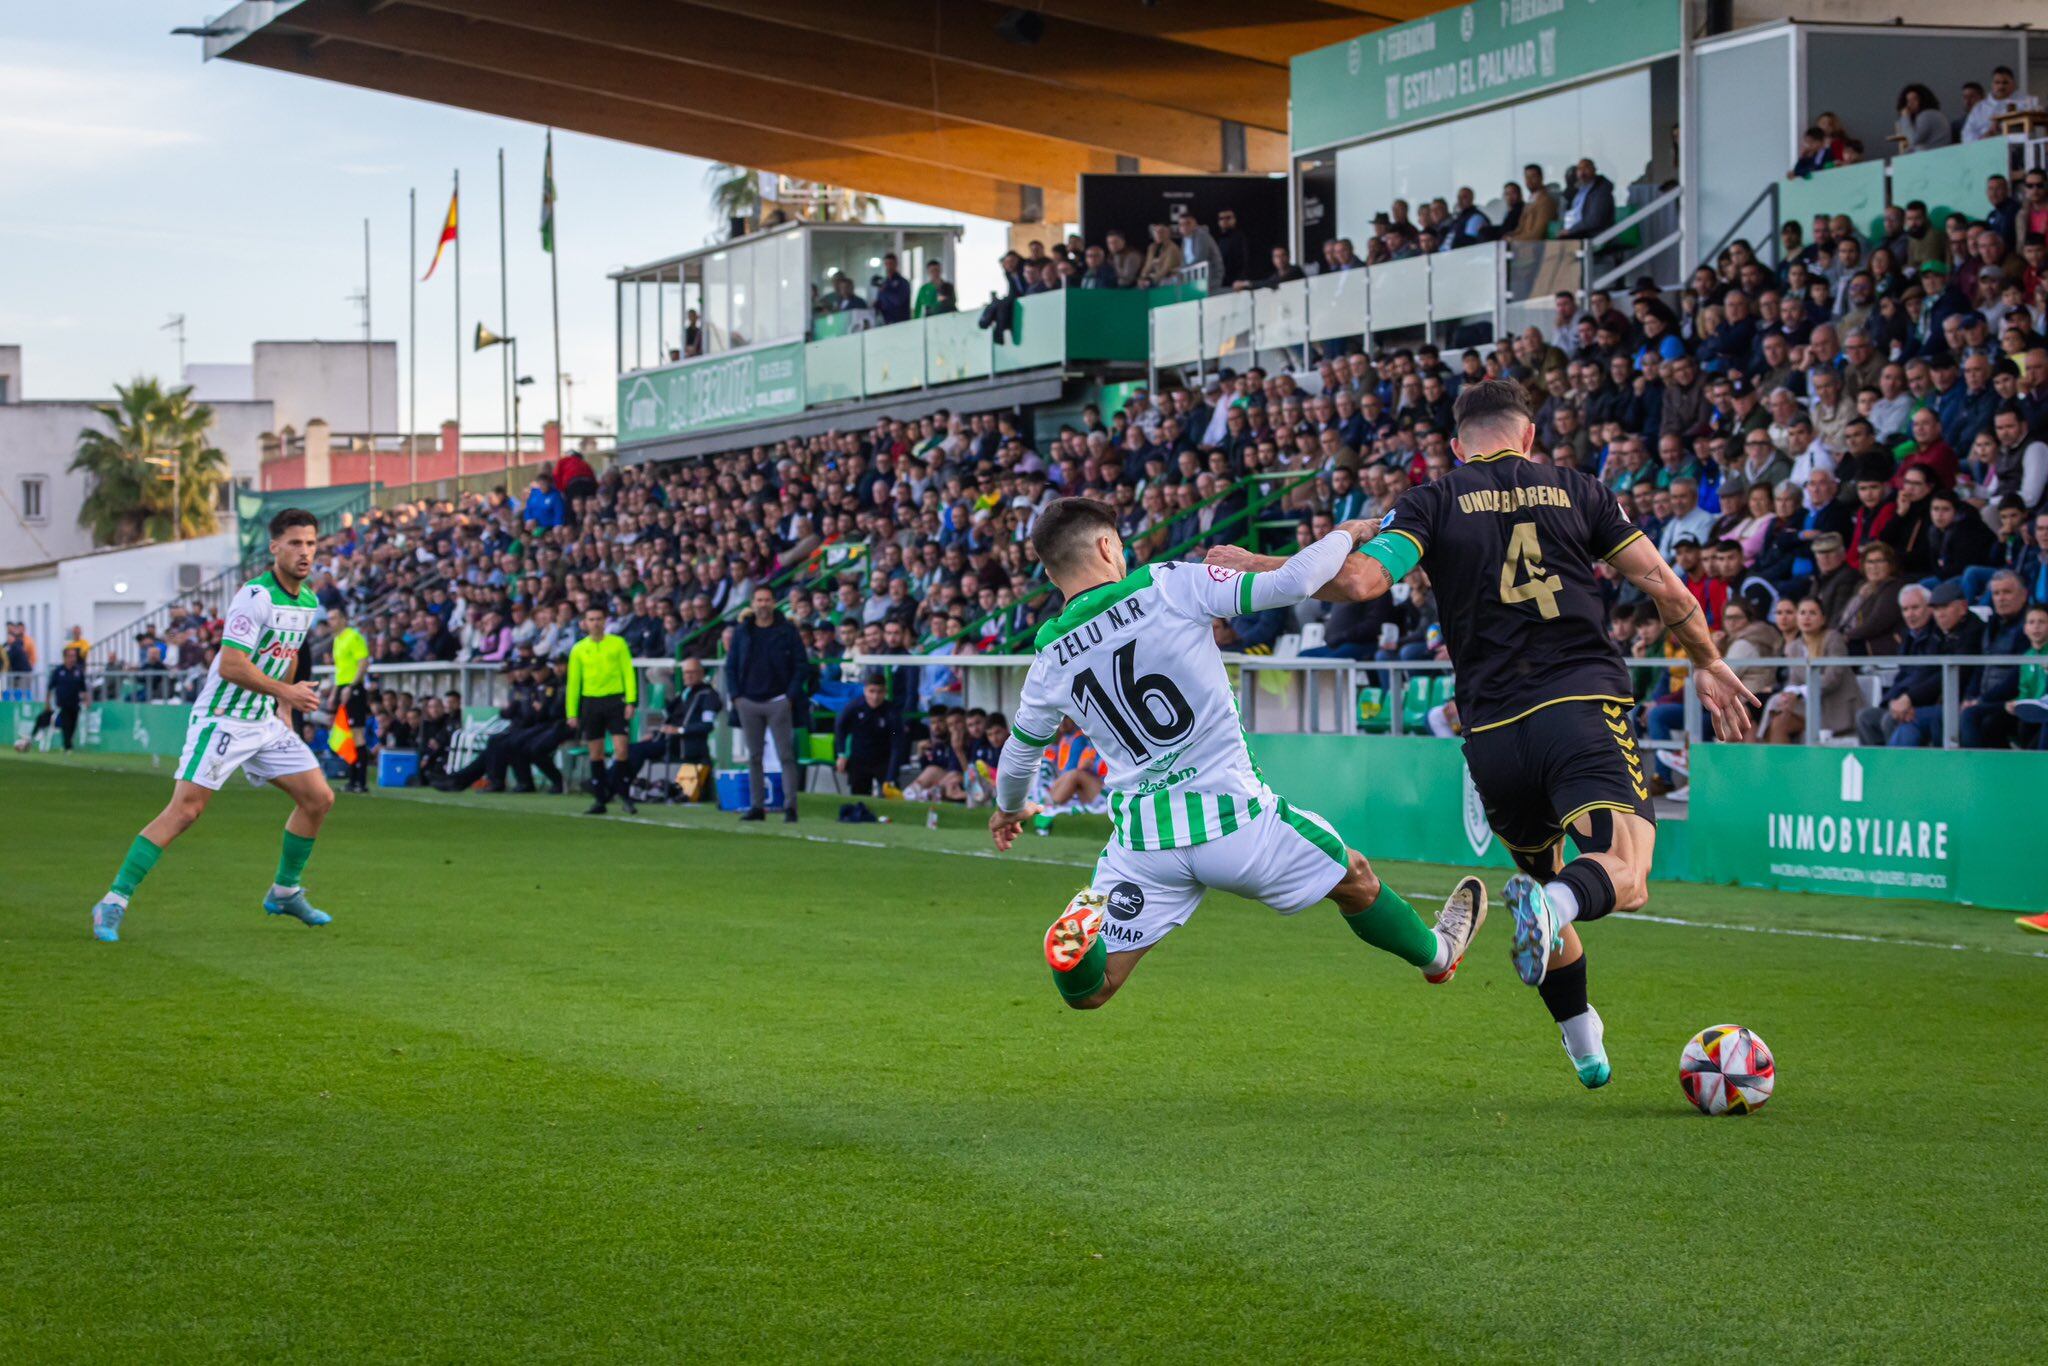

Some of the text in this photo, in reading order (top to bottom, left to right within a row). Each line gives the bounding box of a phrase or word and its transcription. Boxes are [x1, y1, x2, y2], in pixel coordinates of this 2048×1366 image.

[1403, 40, 1537, 110] ESTADIO EL PALMAR
[1500, 522, 1563, 620] 4
[1053, 597, 1146, 666] ZELU N.R
[1071, 638, 1196, 766] 16
[217, 732, 231, 756] 8
[1767, 812, 1949, 860] INMOBYLIARE
